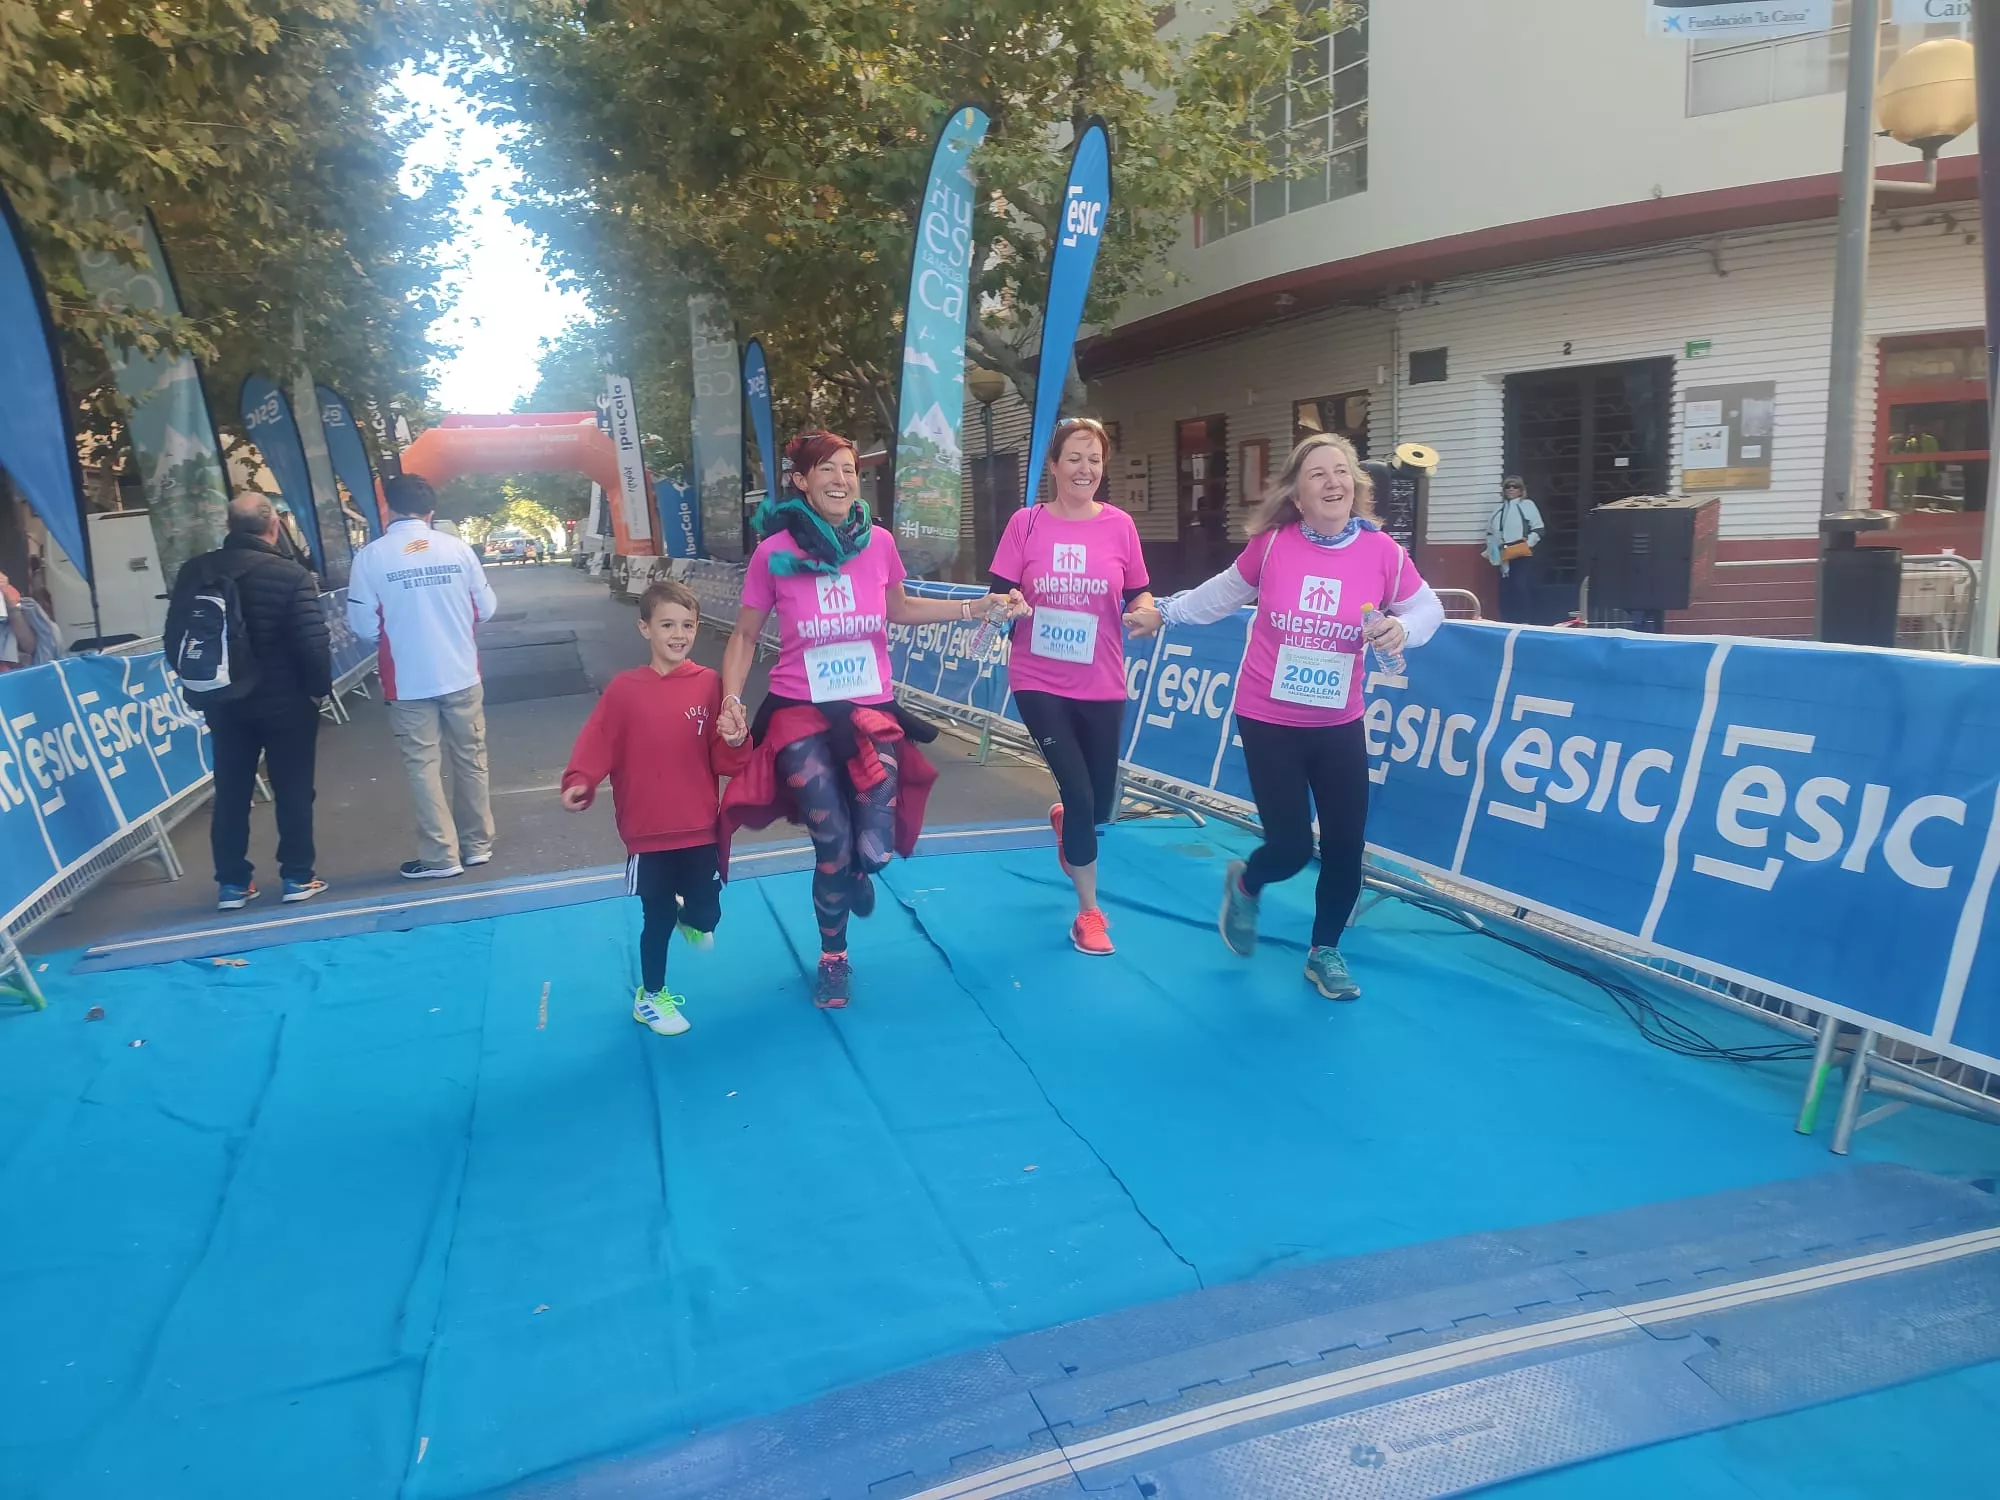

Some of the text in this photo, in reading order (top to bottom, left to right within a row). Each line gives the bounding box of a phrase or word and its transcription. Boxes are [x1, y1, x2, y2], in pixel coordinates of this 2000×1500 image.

[1688, 14, 1753, 29] Fundación
[1066, 199, 1101, 237] esic
[1563, 341, 1572, 356] 2
[1033, 571, 1108, 595] salesianos
[1046, 592, 1090, 606] HUESCA
[797, 613, 882, 639] salesianos
[1040, 623, 1087, 644] 2008
[1270, 609, 1362, 642] salesianos
[1285, 633, 1337, 652] HUESCA
[817, 656, 867, 679] 2007
[1284, 664, 1340, 687] 2006
[1157, 663, 1231, 719] esic
[1280, 682, 1341, 697] MAGDALENA
[88, 702, 142, 758] esic
[697, 719, 704, 736] 7
[1364, 696, 1476, 776] esic
[25, 722, 89, 789] esic
[1501, 727, 1674, 823] esic
[1715, 765, 1967, 889] esic
